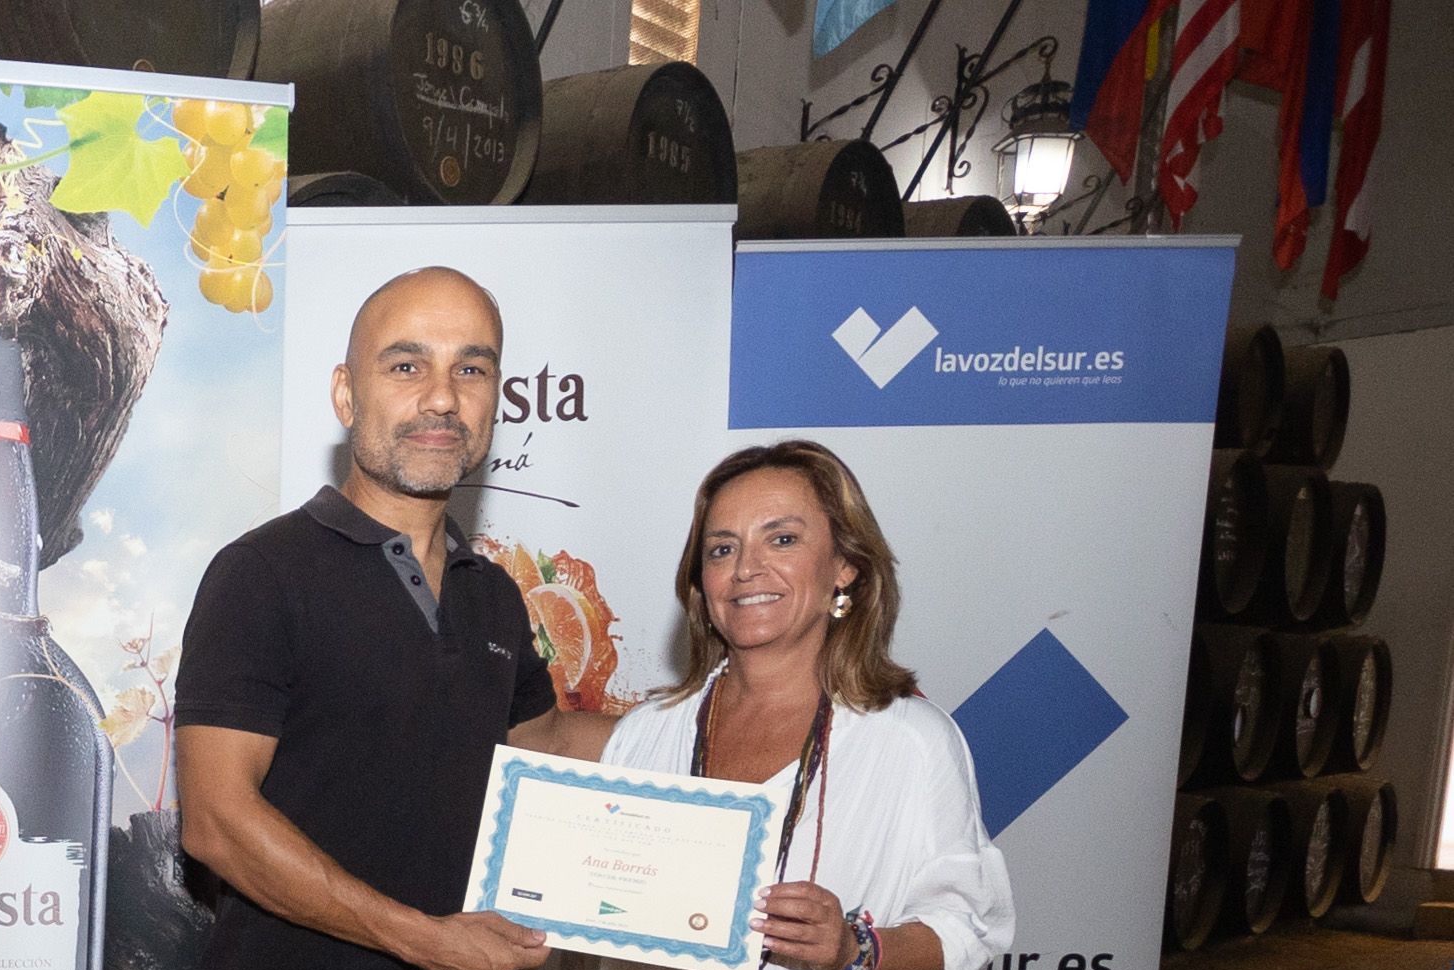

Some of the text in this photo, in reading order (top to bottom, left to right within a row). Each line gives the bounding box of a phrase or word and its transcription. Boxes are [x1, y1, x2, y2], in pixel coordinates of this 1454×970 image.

[934, 345, 1124, 372] lavozdelsur.es
[496, 361, 589, 424] sta
[998, 375, 1123, 387] lo que no quieren que leas
[581, 856, 659, 878] Ana Borrás
